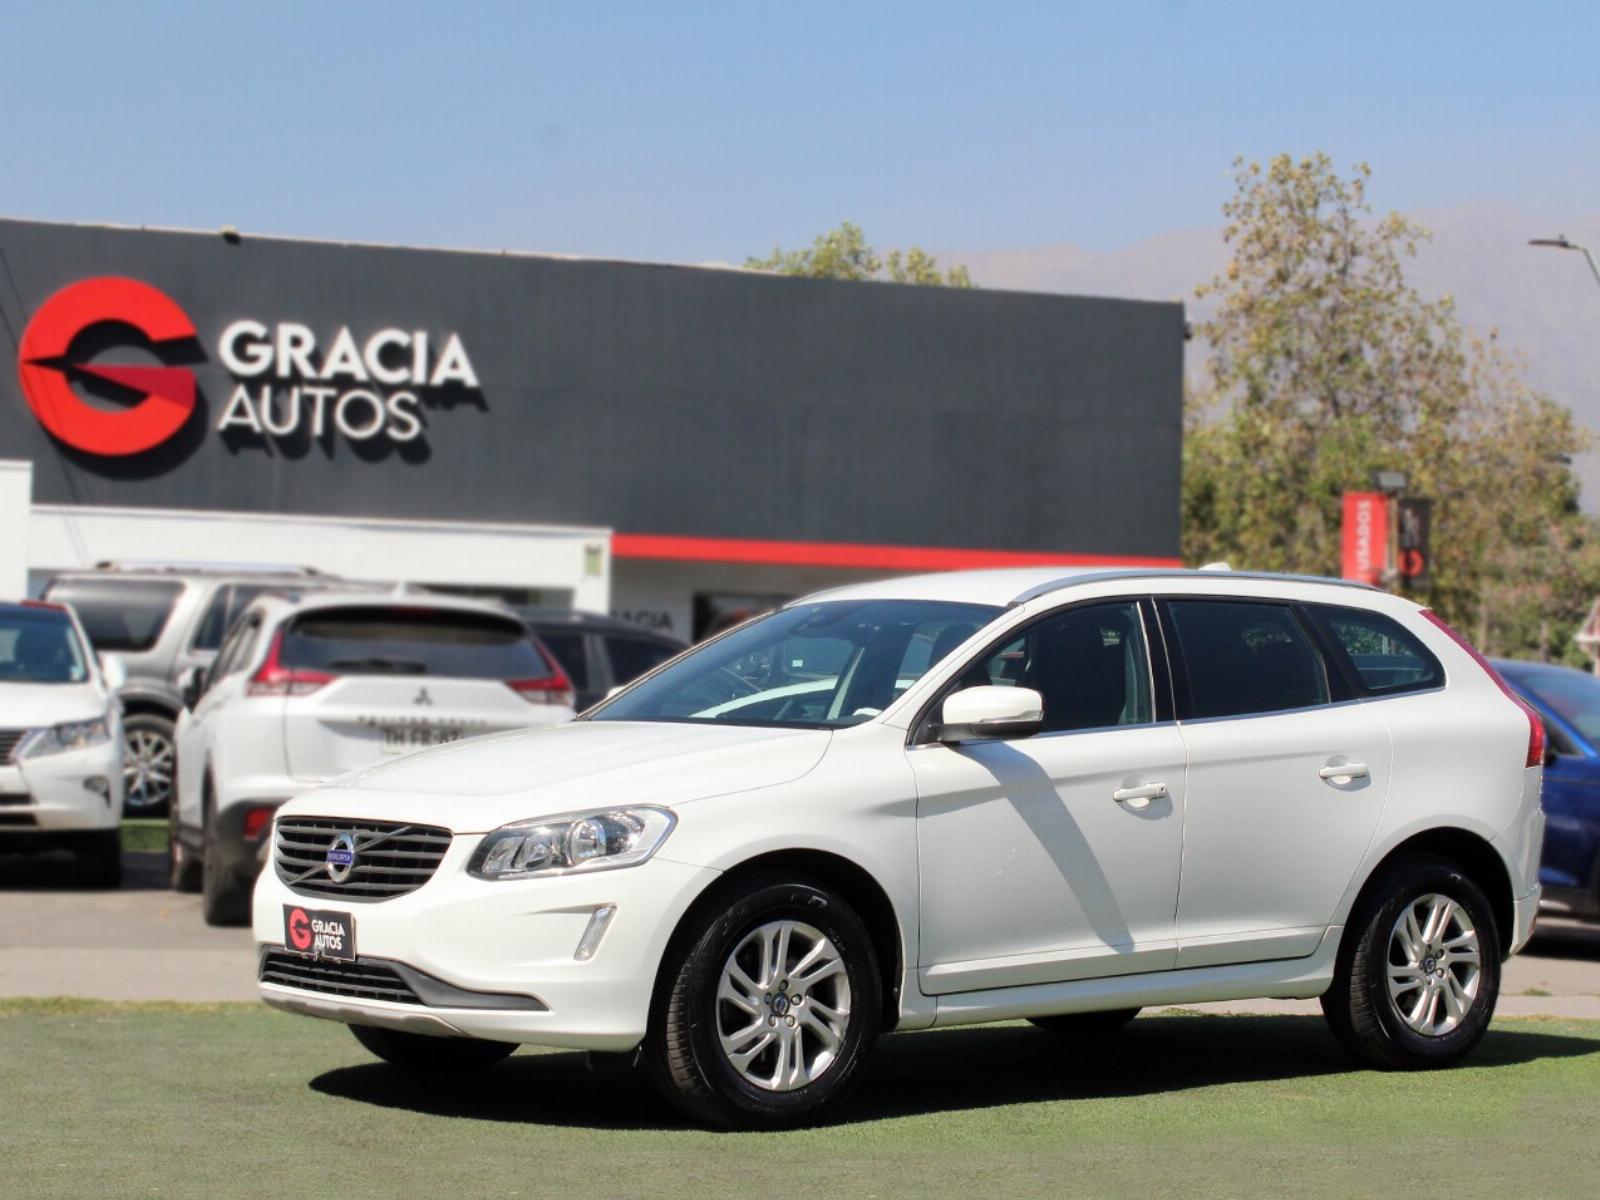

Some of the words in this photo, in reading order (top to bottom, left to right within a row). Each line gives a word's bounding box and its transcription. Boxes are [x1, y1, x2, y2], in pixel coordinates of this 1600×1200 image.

[218, 319, 480, 388] GRACIA
[217, 383, 423, 442] AUTOS
[312, 920, 345, 936] GRACIA
[315, 934, 342, 950] AUTOS
